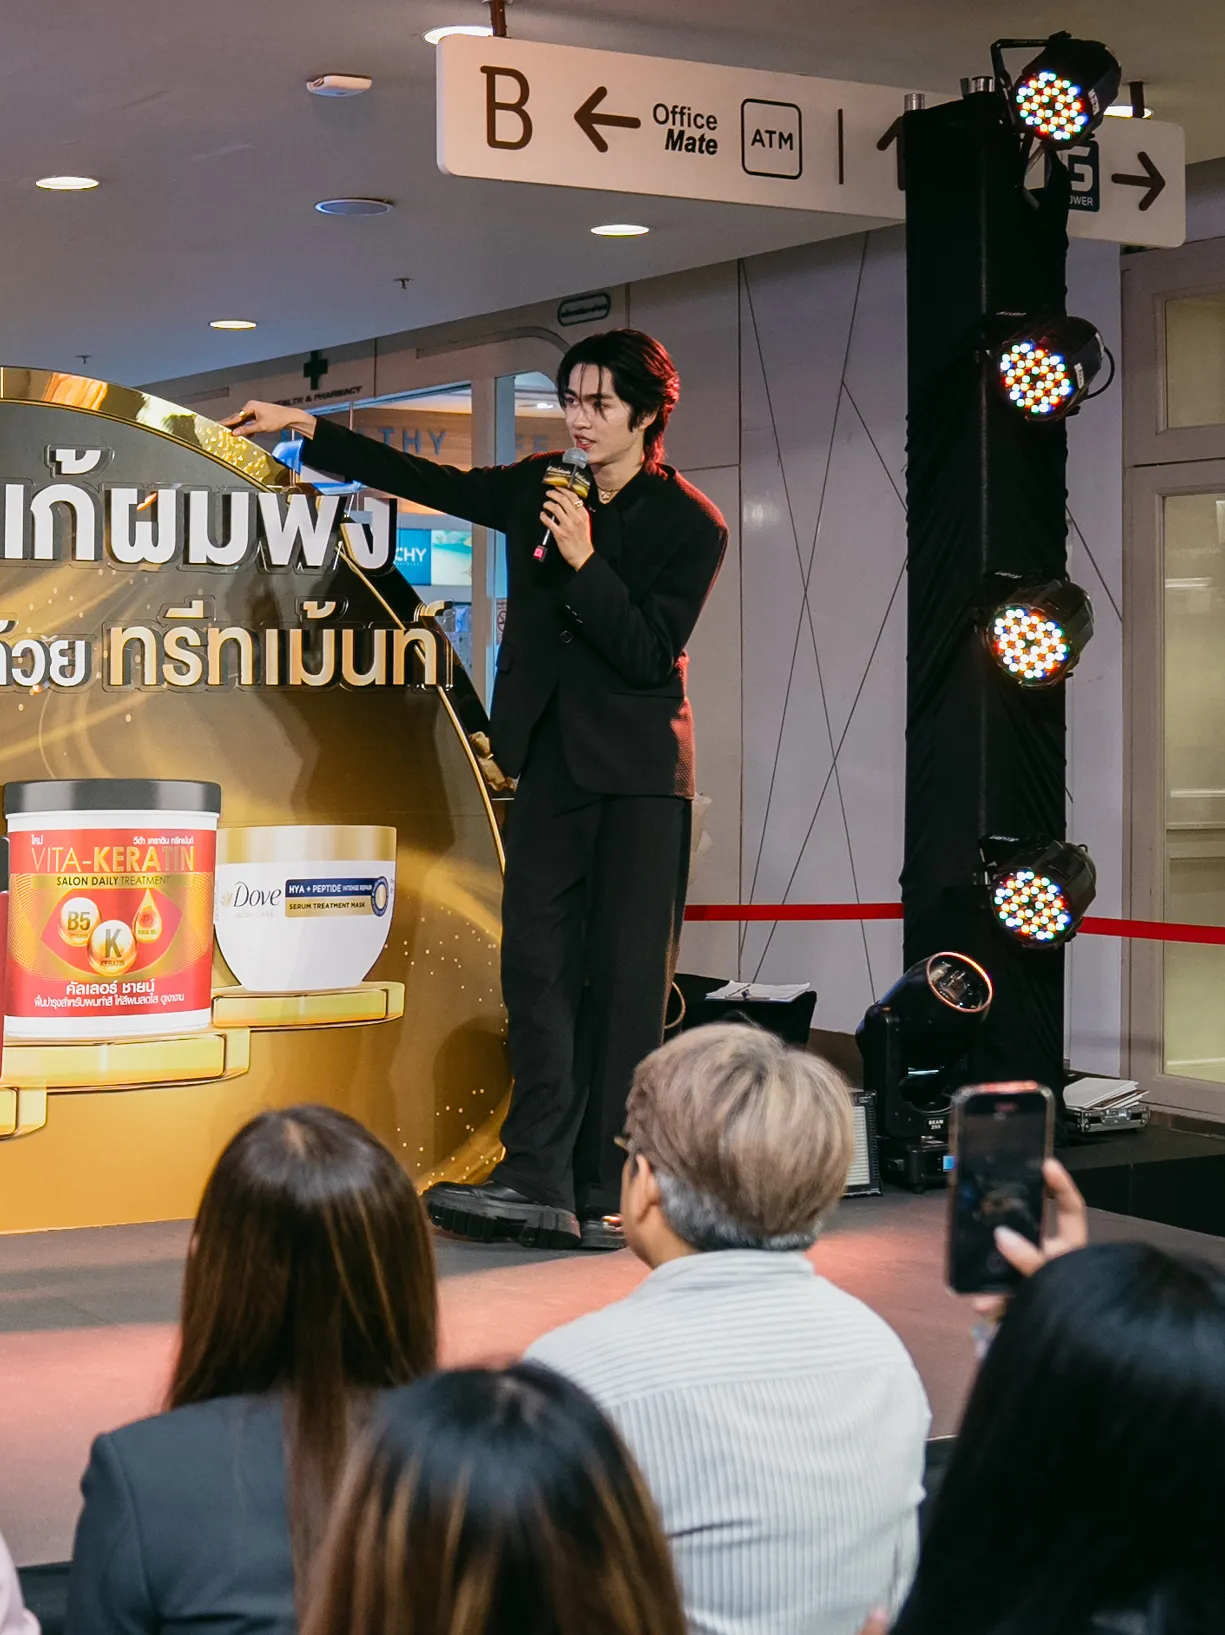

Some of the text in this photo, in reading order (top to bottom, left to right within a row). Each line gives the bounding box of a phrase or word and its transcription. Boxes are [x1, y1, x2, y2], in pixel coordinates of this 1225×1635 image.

[479, 65, 533, 151] B
[651, 101, 719, 131] Office
[664, 126, 720, 157] Mate
[750, 126, 795, 153] ATM
[1070, 195, 1094, 207] WER
[394, 547, 427, 563] CHY
[110, 600, 445, 686] ทรีทเม้นท์
[31, 846, 195, 873] VITA-KERATIN
[57, 875, 170, 886] SALON DAILY TREATMENT
[289, 885, 305, 894] HYA
[312, 884, 342, 893] PEPTIDE
[233, 881, 282, 908] Dove
[313, 902, 350, 910] TREATMENT
[351, 901, 366, 909] MASK
[67, 911, 91, 931] B5
[104, 928, 122, 959] K
[100, 959, 125, 967] KERATIN
[66, 980, 118, 996] คัลเลอร์
